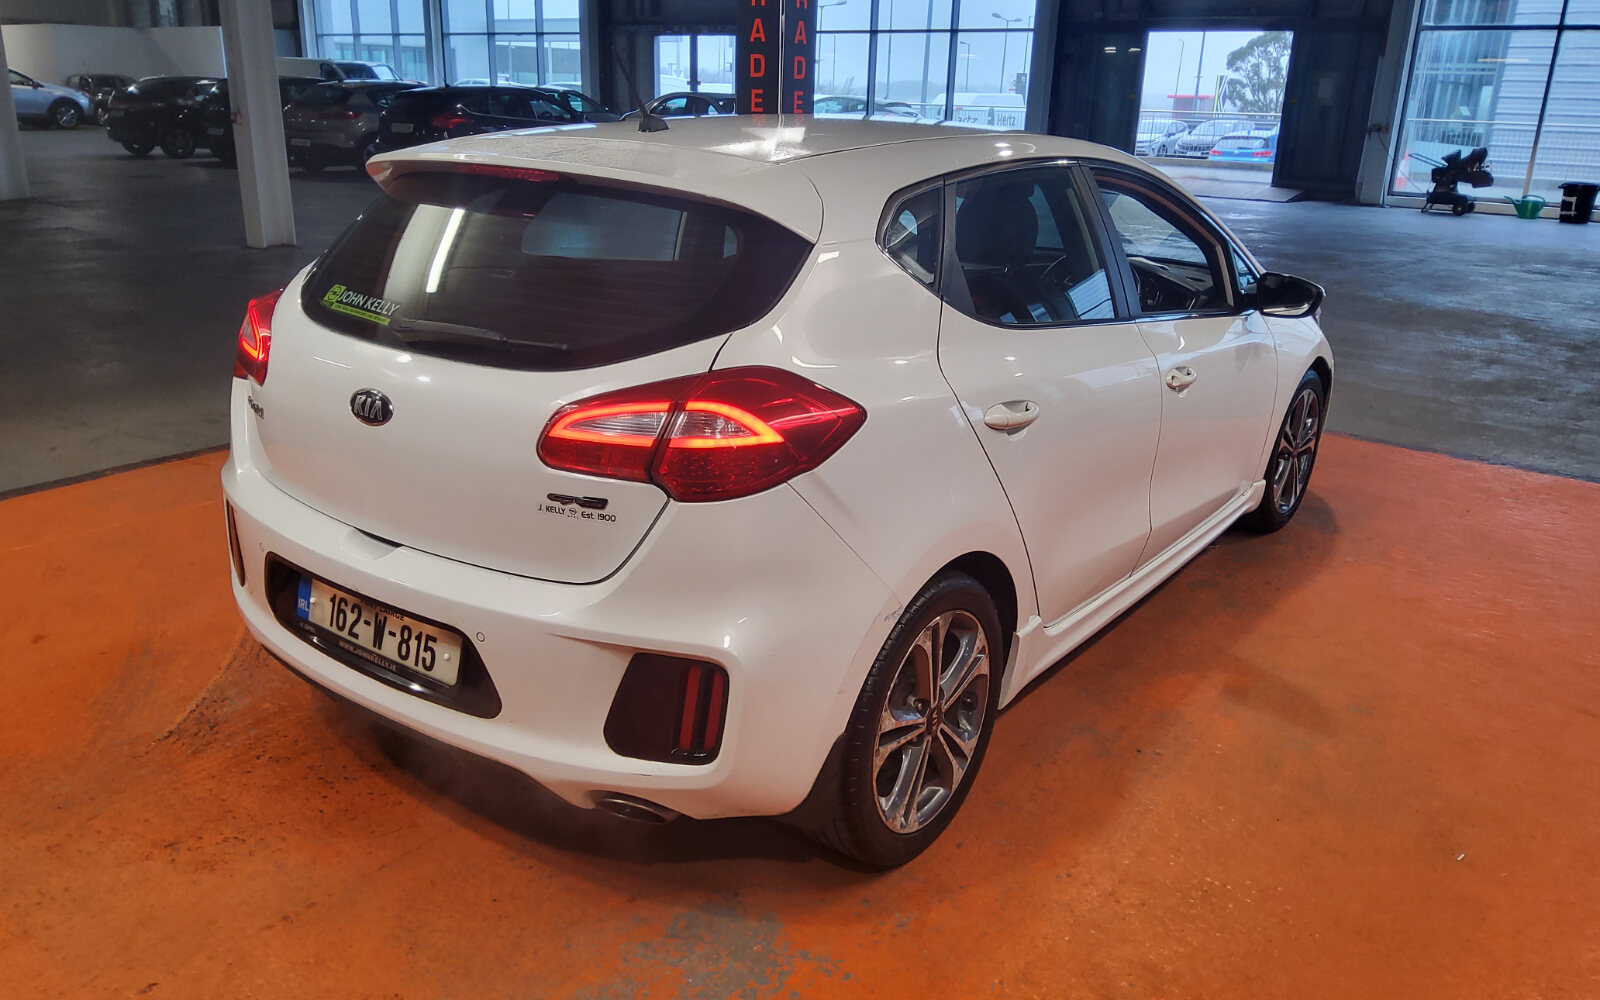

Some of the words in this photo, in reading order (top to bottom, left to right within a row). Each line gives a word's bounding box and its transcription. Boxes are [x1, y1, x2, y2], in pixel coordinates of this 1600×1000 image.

[749, 0, 766, 112] ADE
[997, 113, 1016, 128] Hertz
[338, 290, 368, 307] JOHN
[364, 297, 400, 316] KELLY
[353, 394, 383, 420] KIA
[545, 505, 566, 515] KELLY
[597, 512, 617, 522] 1900
[297, 597, 309, 612] IRL
[330, 593, 438, 672] 162-W-815
